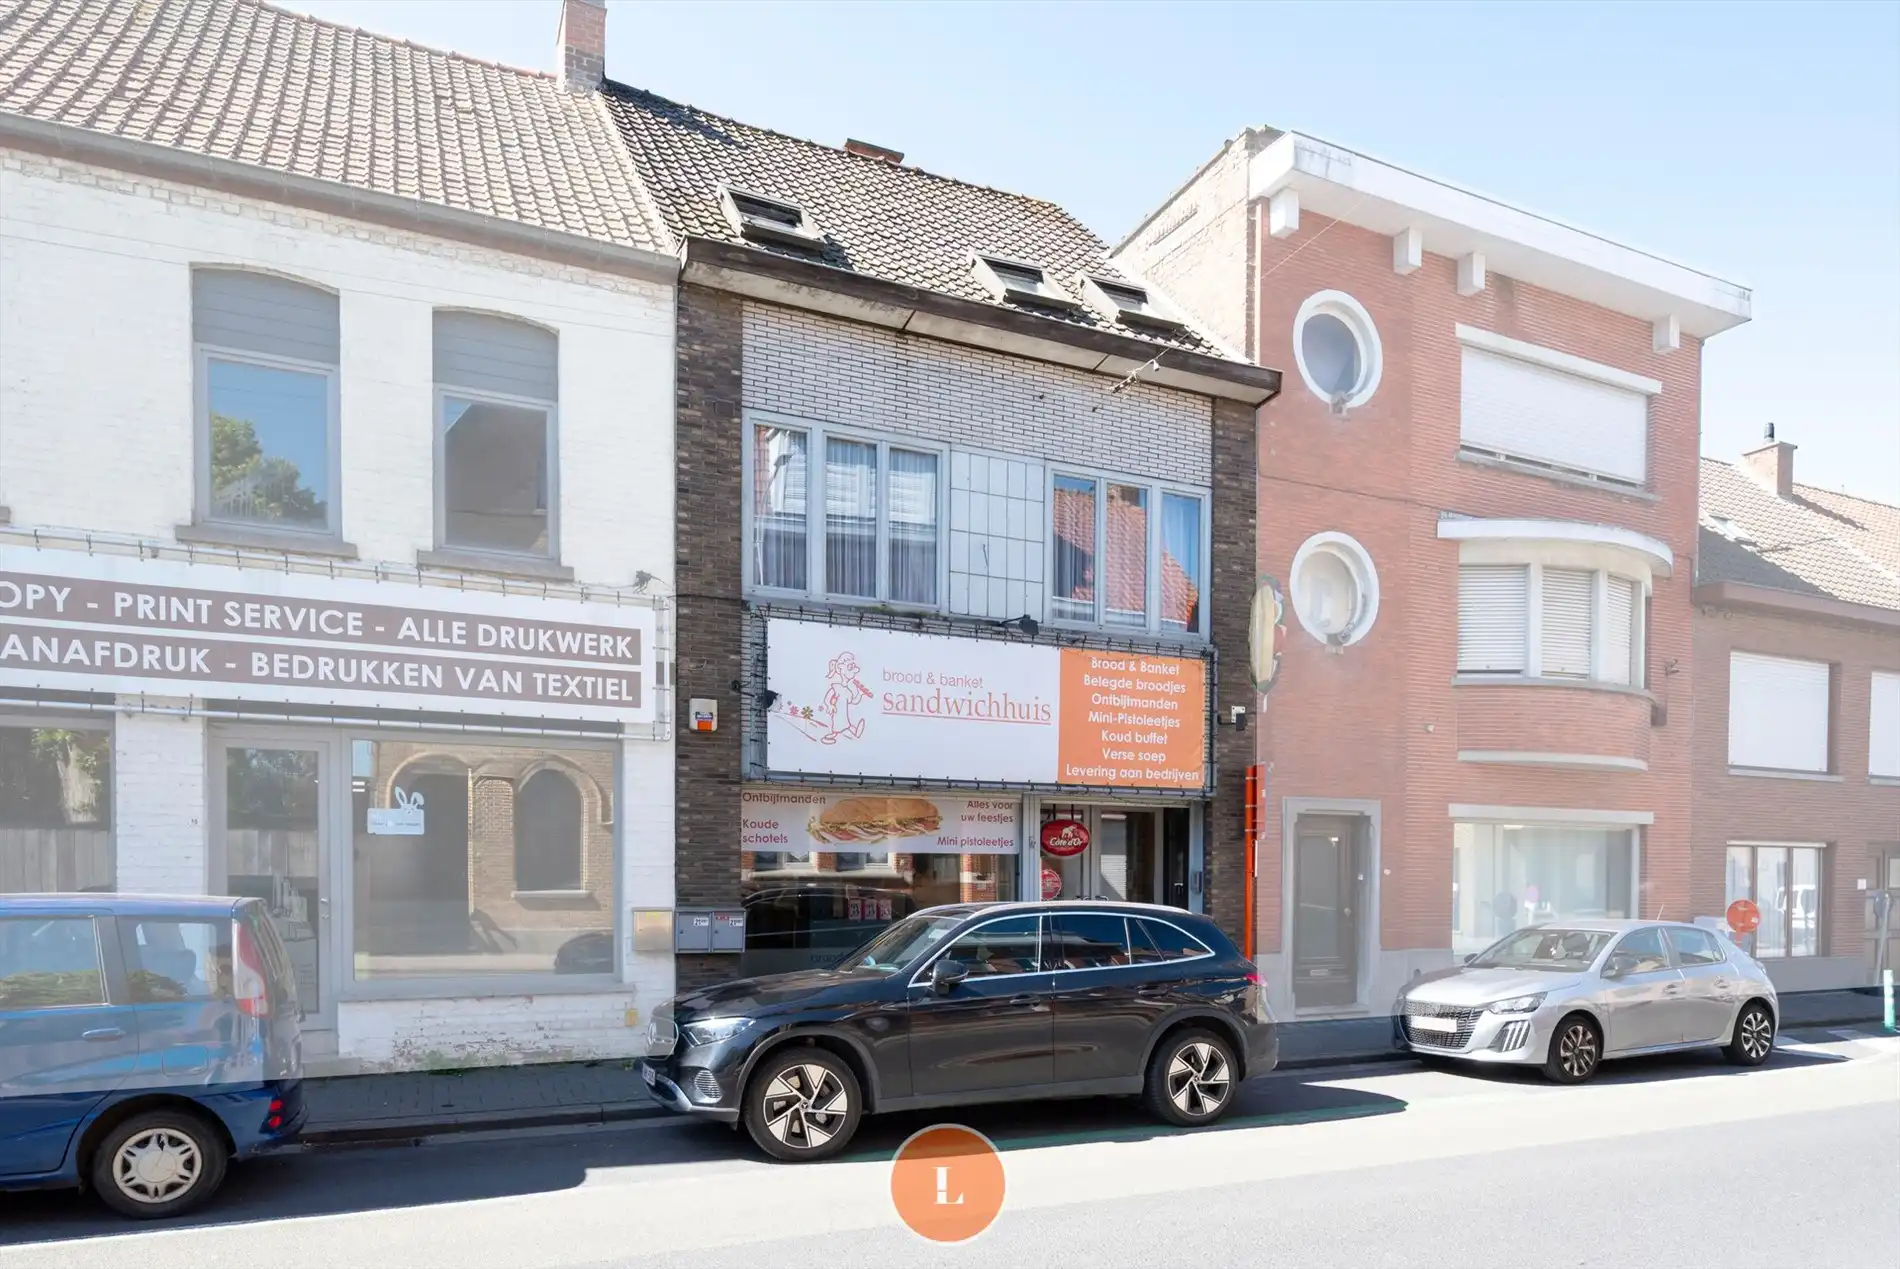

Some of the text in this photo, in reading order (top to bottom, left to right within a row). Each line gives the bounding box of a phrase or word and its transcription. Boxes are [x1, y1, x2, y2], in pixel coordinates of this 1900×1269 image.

[0, 580, 71, 613] OPY
[114, 591, 213, 624] PRINT
[223, 600, 363, 636] SERVICE
[397, 617, 466, 645] ALLE
[477, 623, 632, 659] DRUKWERK
[0, 633, 211, 674] ANAFDRUK
[251, 651, 442, 688] BEDRUKKEN
[454, 666, 523, 694] VAN
[532, 672, 633, 701] TEXTIEL
[1091, 657, 1180, 676] Brood & Banket
[883, 667, 984, 688] brood & banket
[1083, 674, 1186, 695] Belegde broodjes
[883, 688, 1052, 721] sandwichhuis
[1091, 692, 1178, 711] Ontbijtmanden
[1088, 711, 1181, 730] Mini-Pistoleetjes
[1101, 730, 1168, 745] Koud buffet
[1102, 747, 1167, 764] Verse soep
[1066, 763, 1199, 783] Levering aan bedrijven
[742, 792, 826, 805] Ontbijtmanden
[967, 800, 1013, 810] Alles voor
[742, 819, 779, 829] Koude
[961, 812, 1014, 824] uw feestjes
[742, 833, 788, 844] schotels
[937, 836, 1014, 848] Mini pistoleetjes
